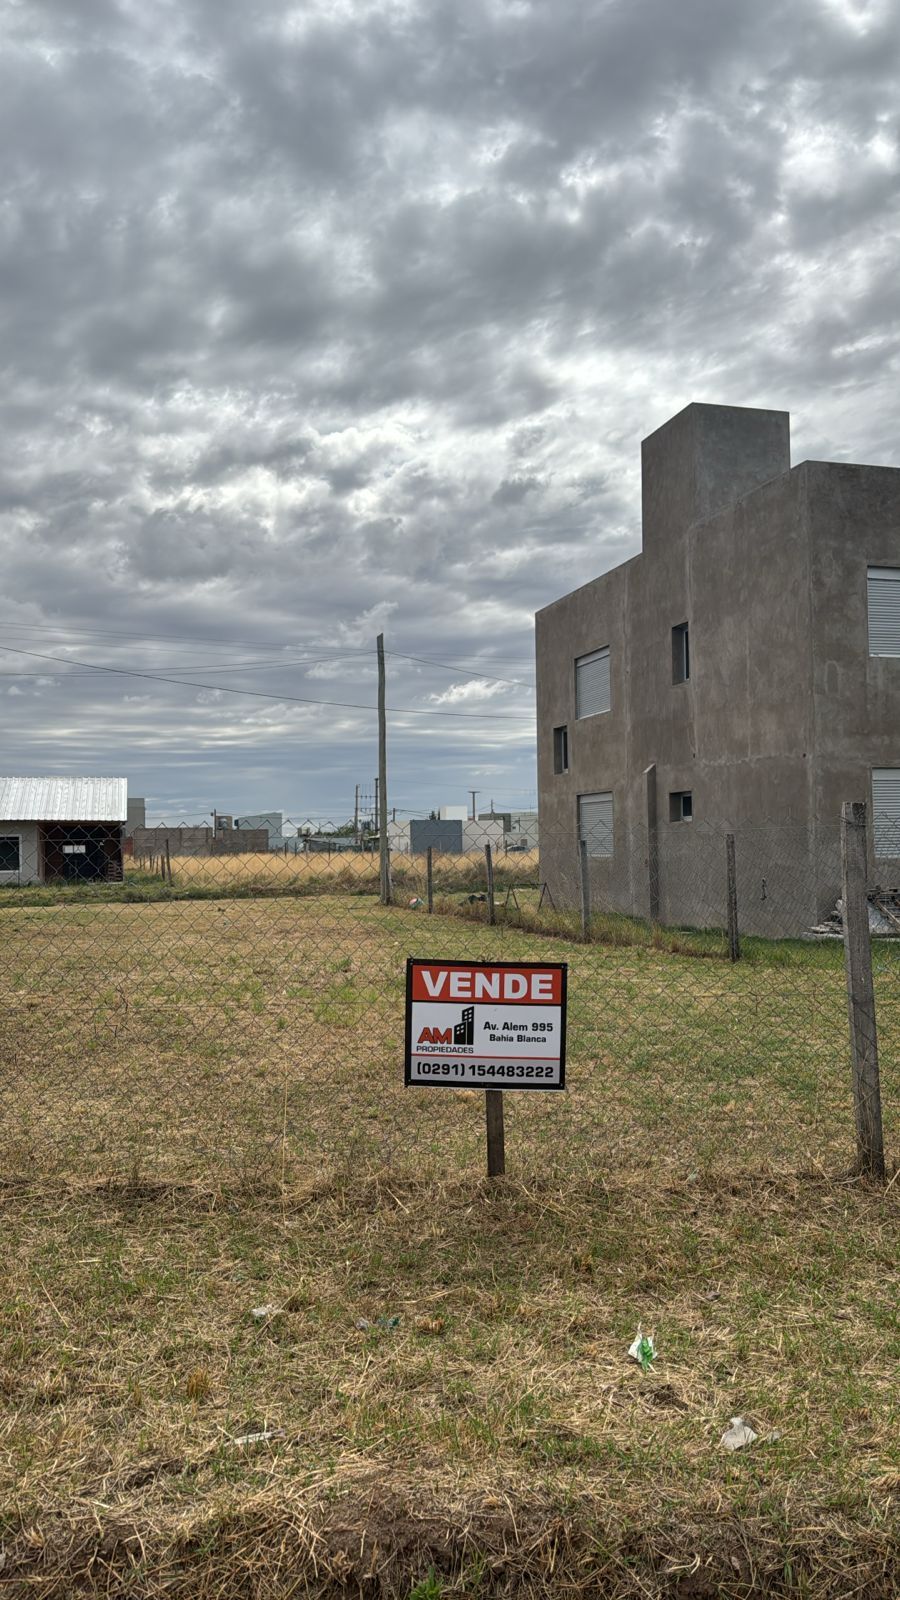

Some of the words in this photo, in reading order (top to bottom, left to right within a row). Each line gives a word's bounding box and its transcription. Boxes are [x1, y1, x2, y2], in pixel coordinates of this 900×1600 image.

[421, 971, 553, 1000] VENDE
[483, 1022, 499, 1031] Av.
[502, 1022, 528, 1031] Alem
[532, 1022, 553, 1032] 995
[417, 1027, 452, 1044] AM
[416, 1046, 474, 1054] PROPIEDADES
